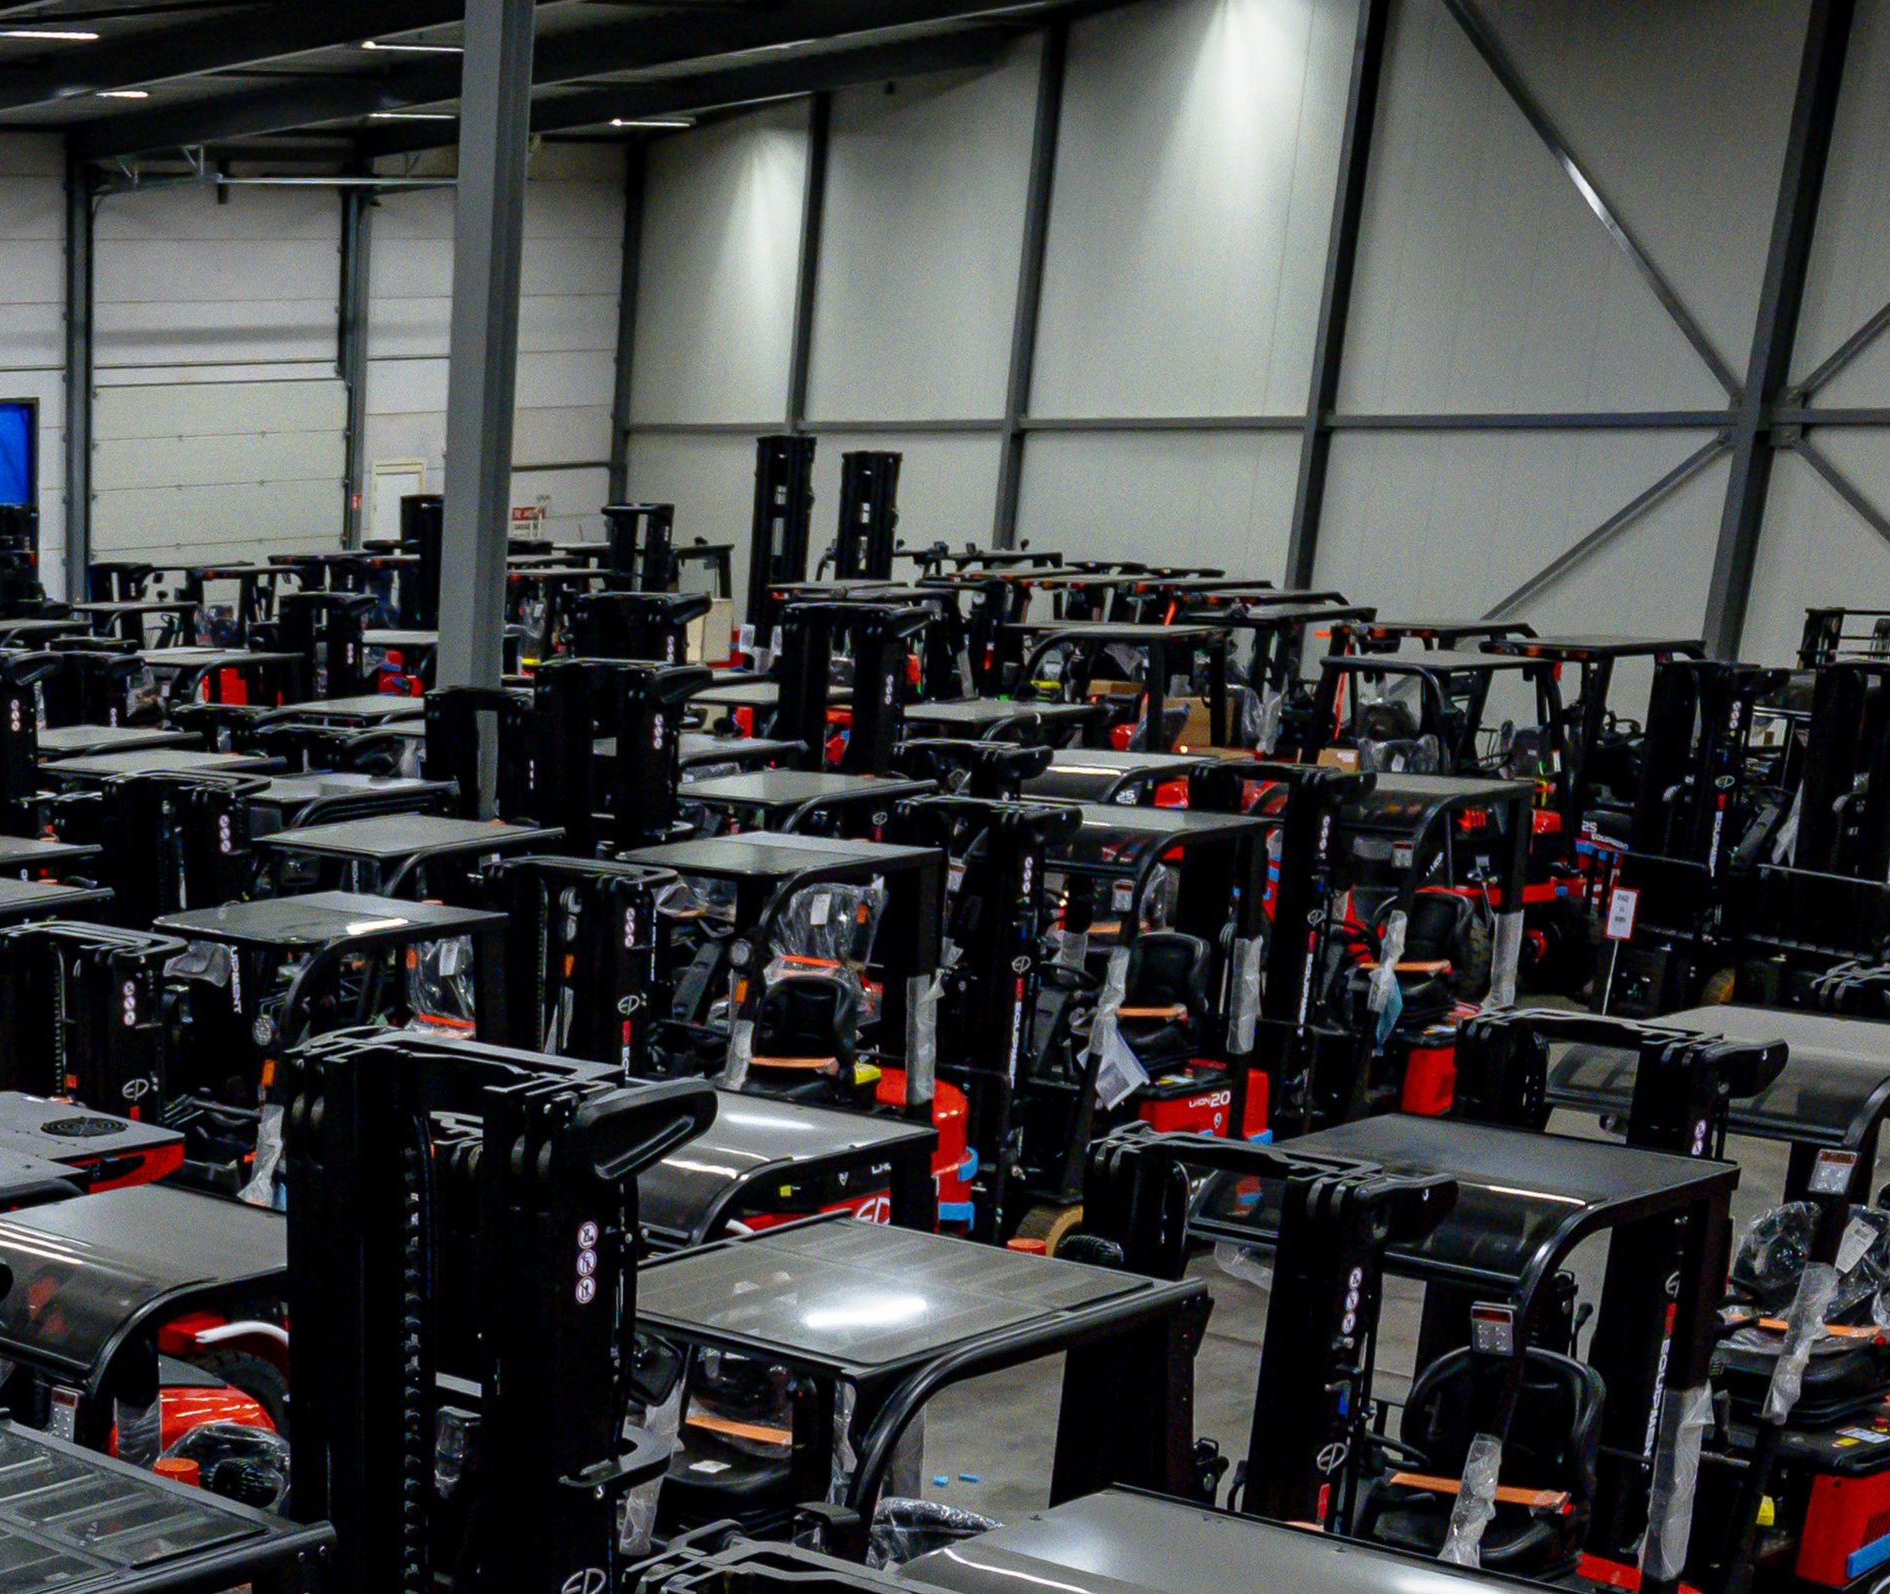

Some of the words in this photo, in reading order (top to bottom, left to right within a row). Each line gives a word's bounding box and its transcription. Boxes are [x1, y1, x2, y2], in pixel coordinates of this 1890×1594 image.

[121, 1077, 150, 1102] EP
[1209, 1089, 1232, 1109] 20
[1316, 1442, 1348, 1476] EP
